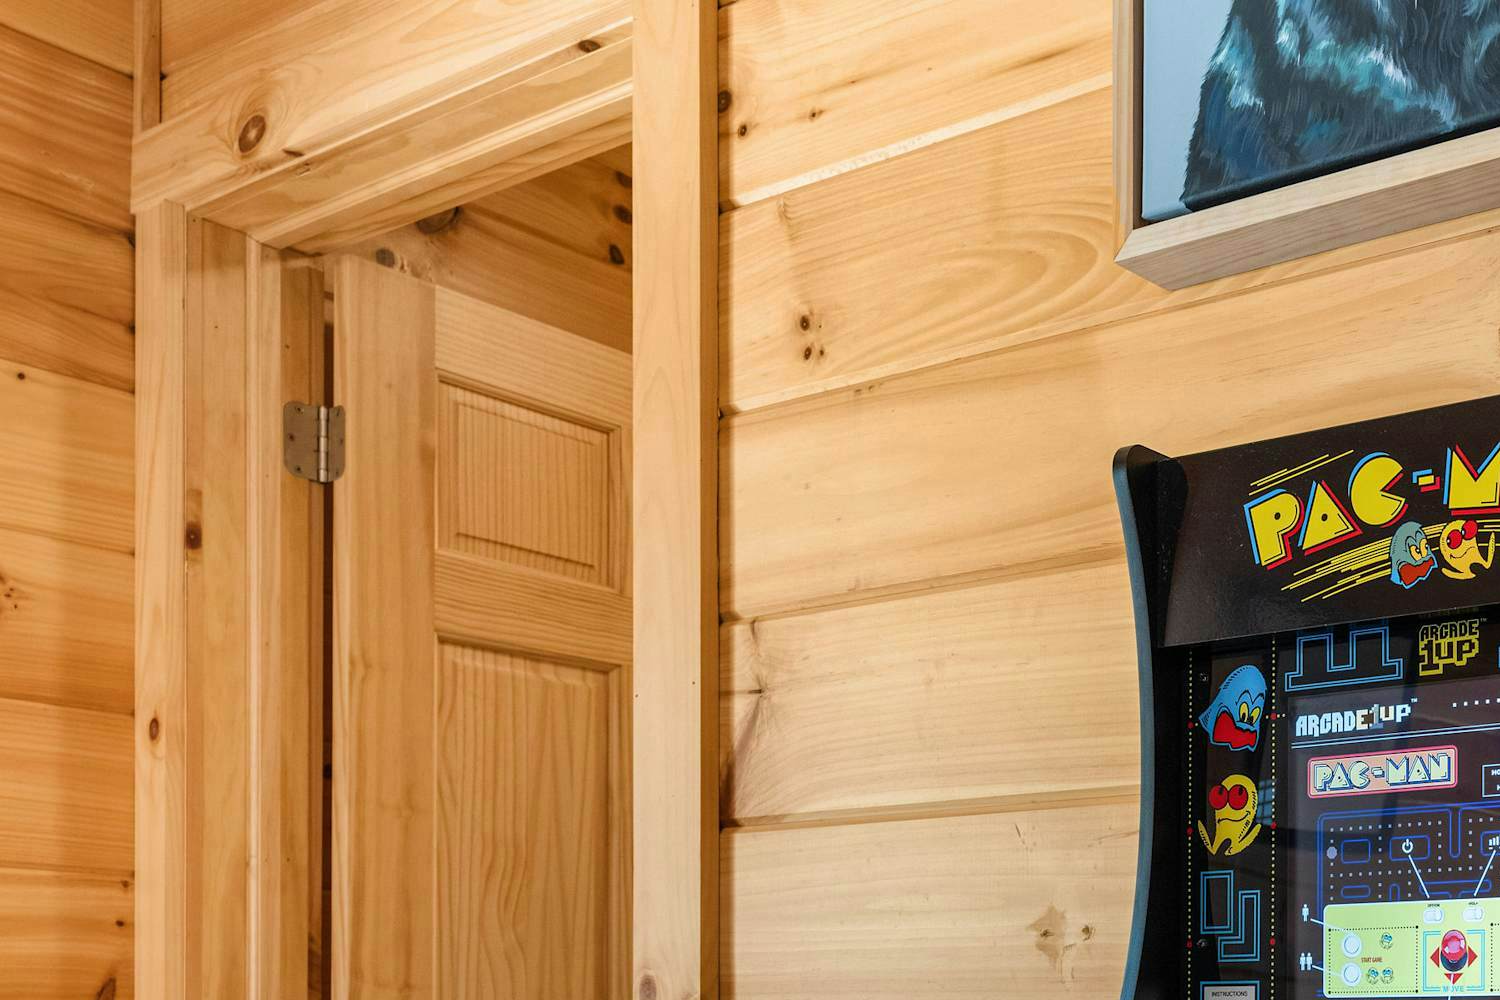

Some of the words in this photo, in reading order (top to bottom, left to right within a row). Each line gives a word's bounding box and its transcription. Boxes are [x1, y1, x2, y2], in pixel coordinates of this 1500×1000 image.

[1419, 619, 1479, 641] ARCADE
[1419, 637, 1479, 676] 1UP
[1313, 752, 1451, 792] PAC-MAN
